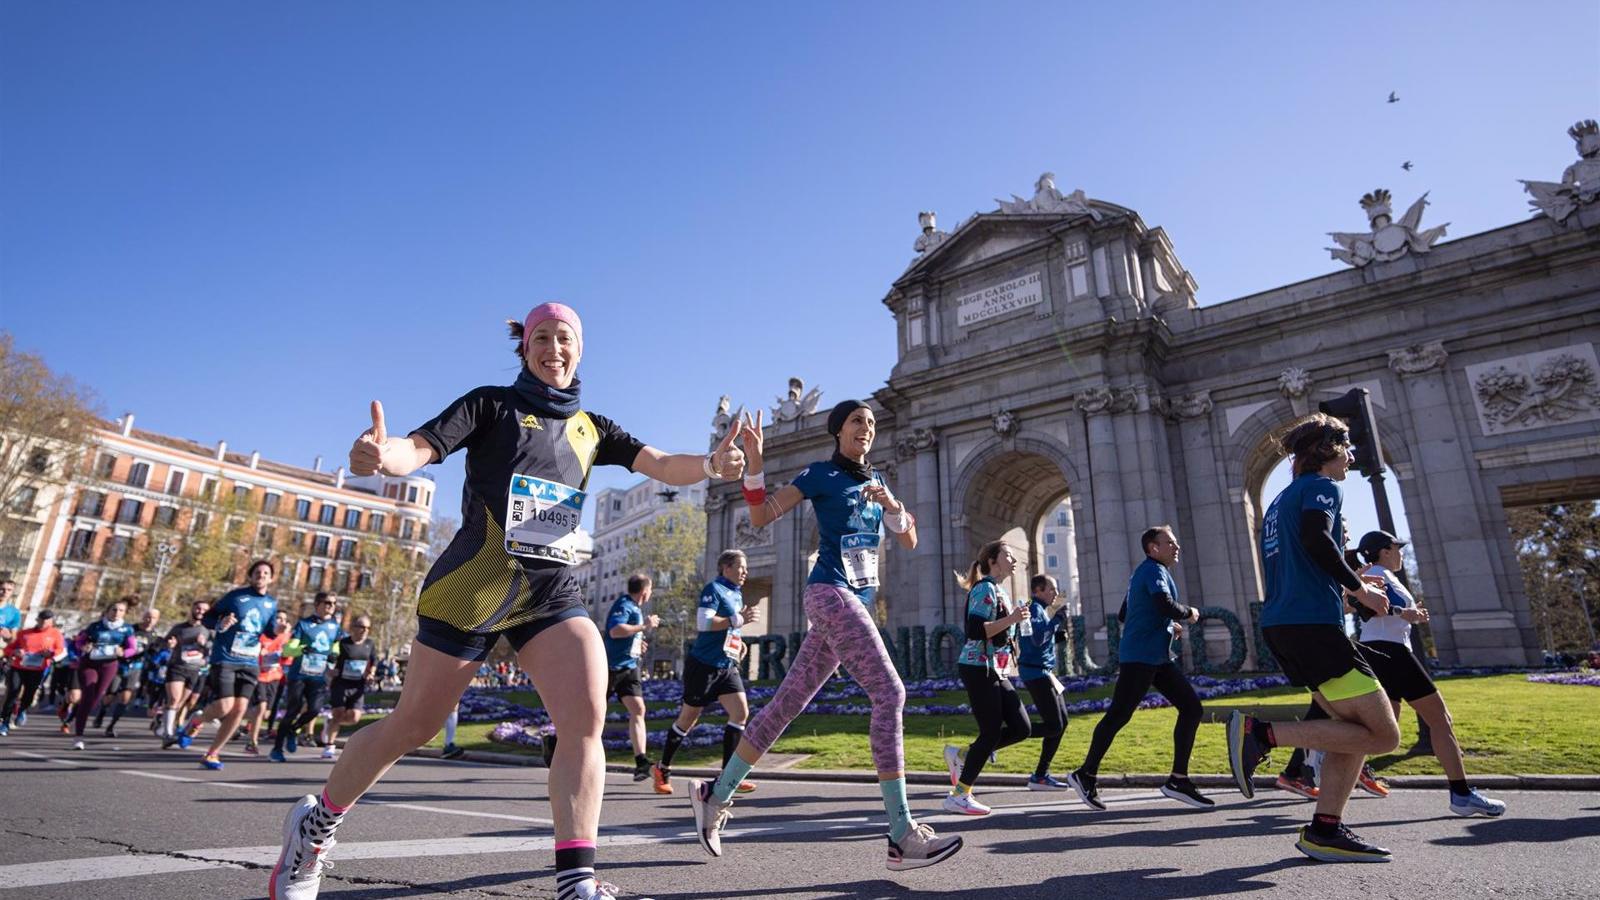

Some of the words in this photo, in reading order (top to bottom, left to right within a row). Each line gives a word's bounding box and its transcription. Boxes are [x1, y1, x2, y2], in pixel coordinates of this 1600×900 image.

[984, 280, 1026, 298] CAROLO
[963, 294, 1036, 323] MDCCLXXVIII
[983, 292, 1014, 308] ANNO
[531, 508, 568, 527] 10495
